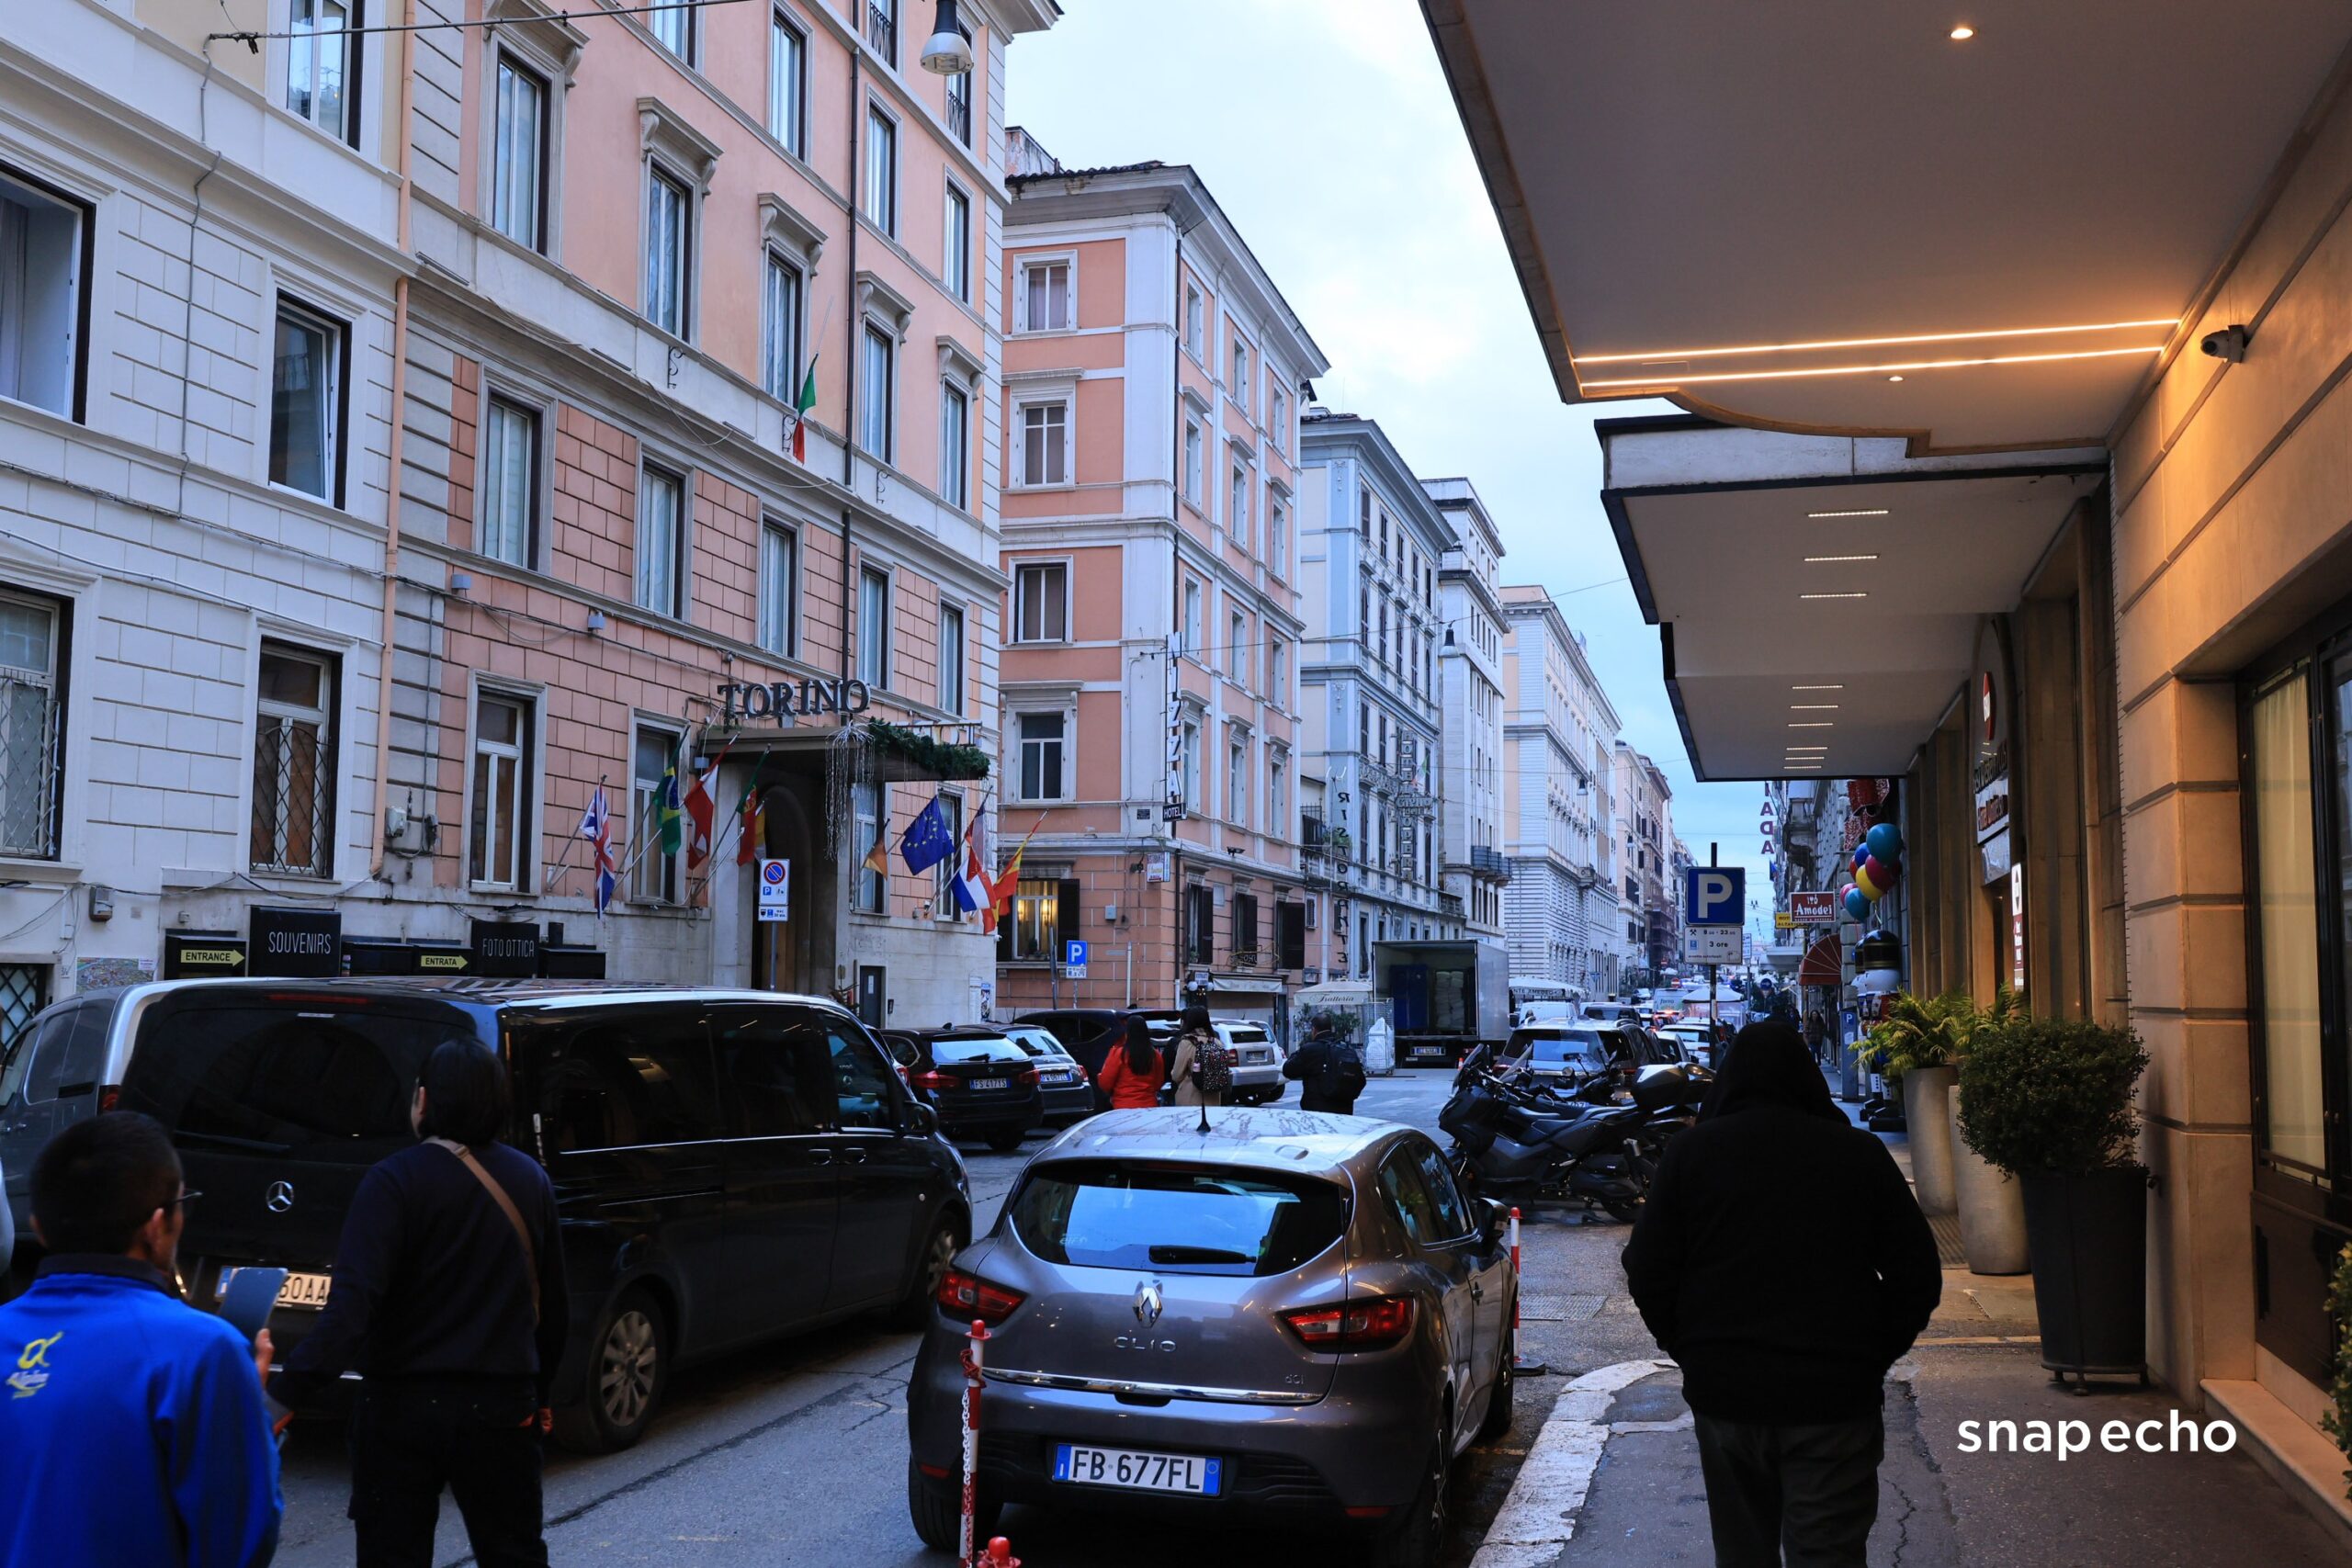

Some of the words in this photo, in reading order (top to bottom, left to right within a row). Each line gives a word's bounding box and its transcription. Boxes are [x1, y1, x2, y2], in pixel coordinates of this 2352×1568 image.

[717, 679, 871, 720] TORINO
[1167, 632, 1182, 797] NIZZA
[1163, 807, 1182, 819] HOTEL
[1698, 874, 1733, 919] P
[1795, 903, 1833, 916] Amodei
[267, 931, 332, 954] SOUVENIRS
[482, 938, 504, 957] FOTO
[505, 939, 535, 958] OTTICA
[186, 952, 231, 962] ENTRANCE
[425, 957, 458, 966] ENTRATA
[1071, 944, 1083, 963] P
[1846, 1013, 1853, 1023] P
[1114, 1336, 1177, 1352] CLIO
[1072, 1450, 1106, 1480] FB
[1116, 1454, 1200, 1490] 677FL
